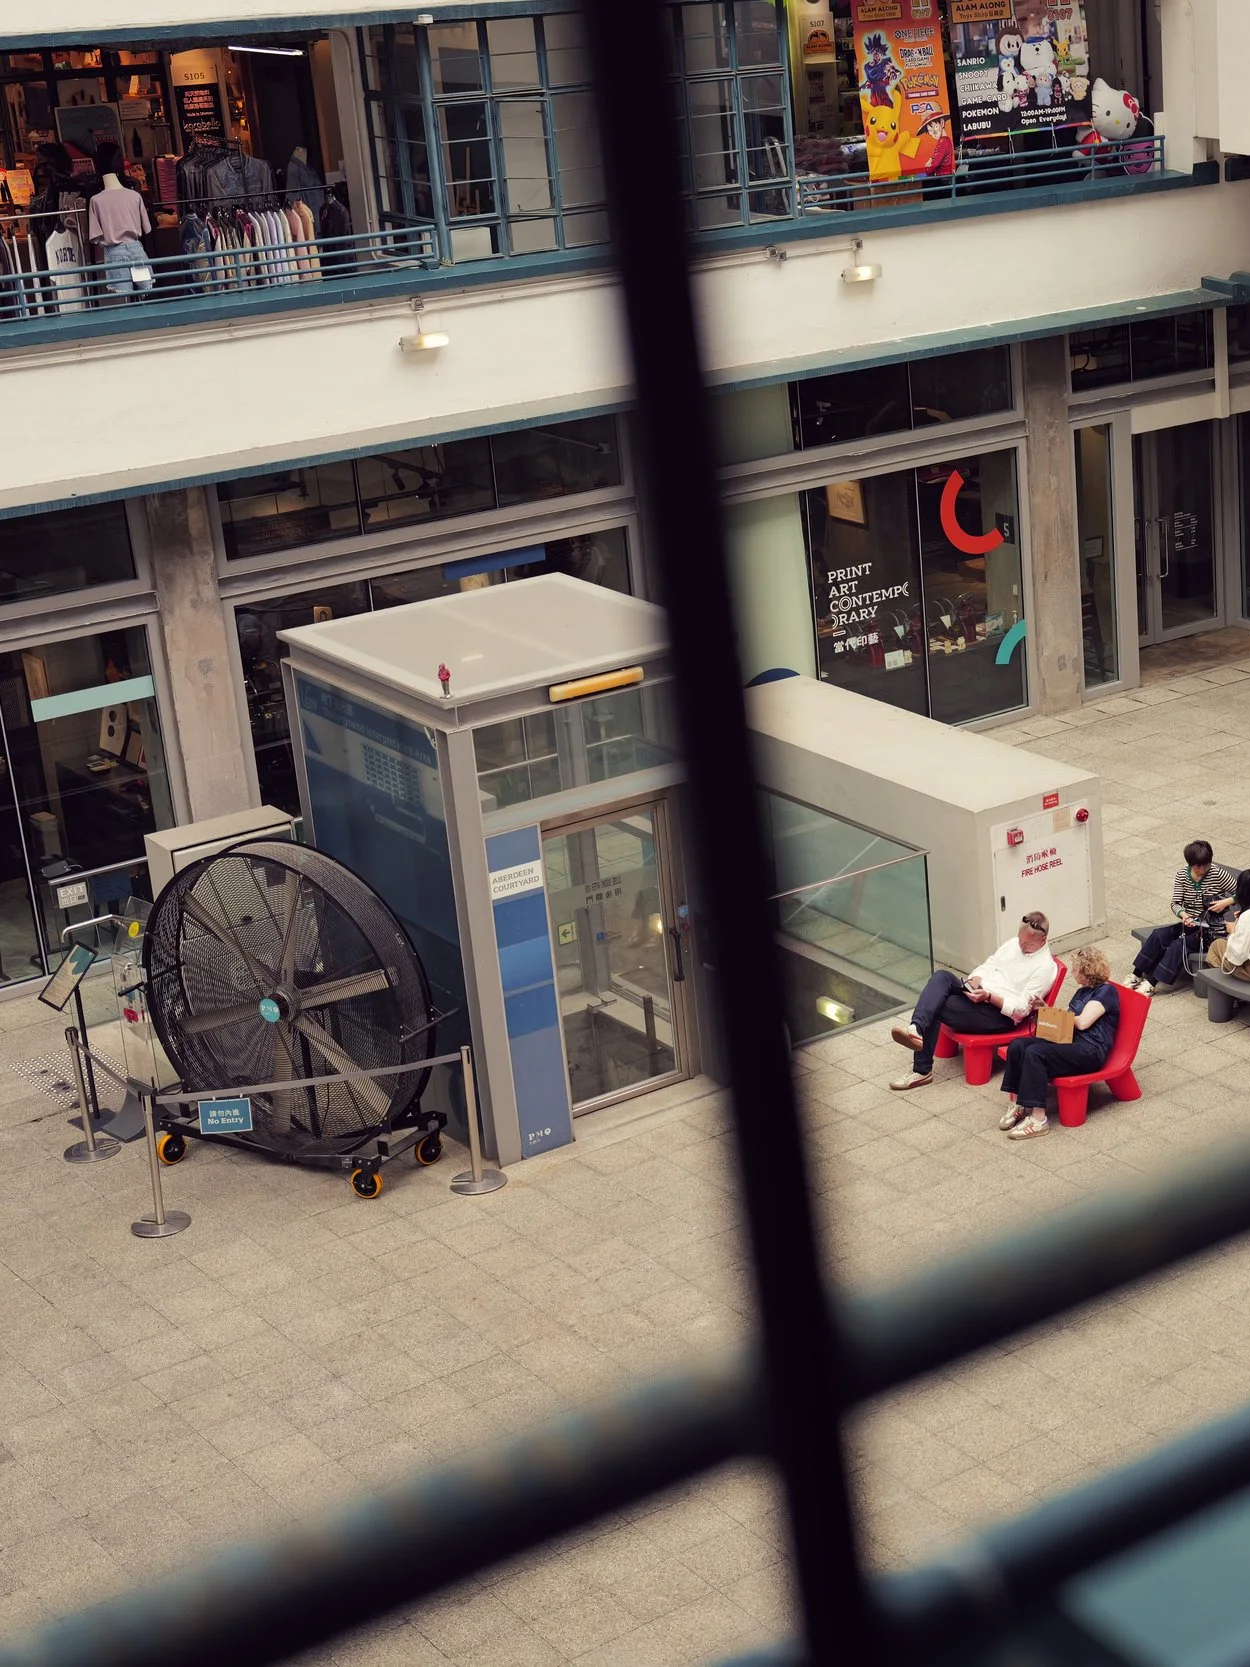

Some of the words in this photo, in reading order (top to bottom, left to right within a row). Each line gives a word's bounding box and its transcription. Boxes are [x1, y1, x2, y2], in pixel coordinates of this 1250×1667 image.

[956, 3, 977, 12] ALAM
[979, 1, 1006, 9] ALONG
[894, 29, 913, 39] ONE
[957, 57, 985, 67] SANRIO
[184, 72, 205, 80] S105
[958, 70, 989, 80] SNOOPY
[960, 82, 998, 93] CHIIKAWA
[961, 96, 983, 105] GAME
[986, 93, 1007, 102] CARD
[911, 102, 934, 113] PSA
[962, 107, 999, 118] POKEMON
[963, 121, 992, 131] LABUBU
[1021, 118, 1037, 126] Open
[1003, 522, 1010, 537] 5
[827, 562, 872, 583] PRINT
[828, 580, 858, 598] ART
[833, 632, 879, 653] 當代印藝
[1021, 867, 1034, 878] FIRE
[1034, 862, 1049, 873] HOSE
[1049, 858, 1063, 868] REEL
[492, 867, 534, 884] ABERDEEN
[493, 875, 540, 893] COURTYARD
[60, 884, 85, 897] EXIT
